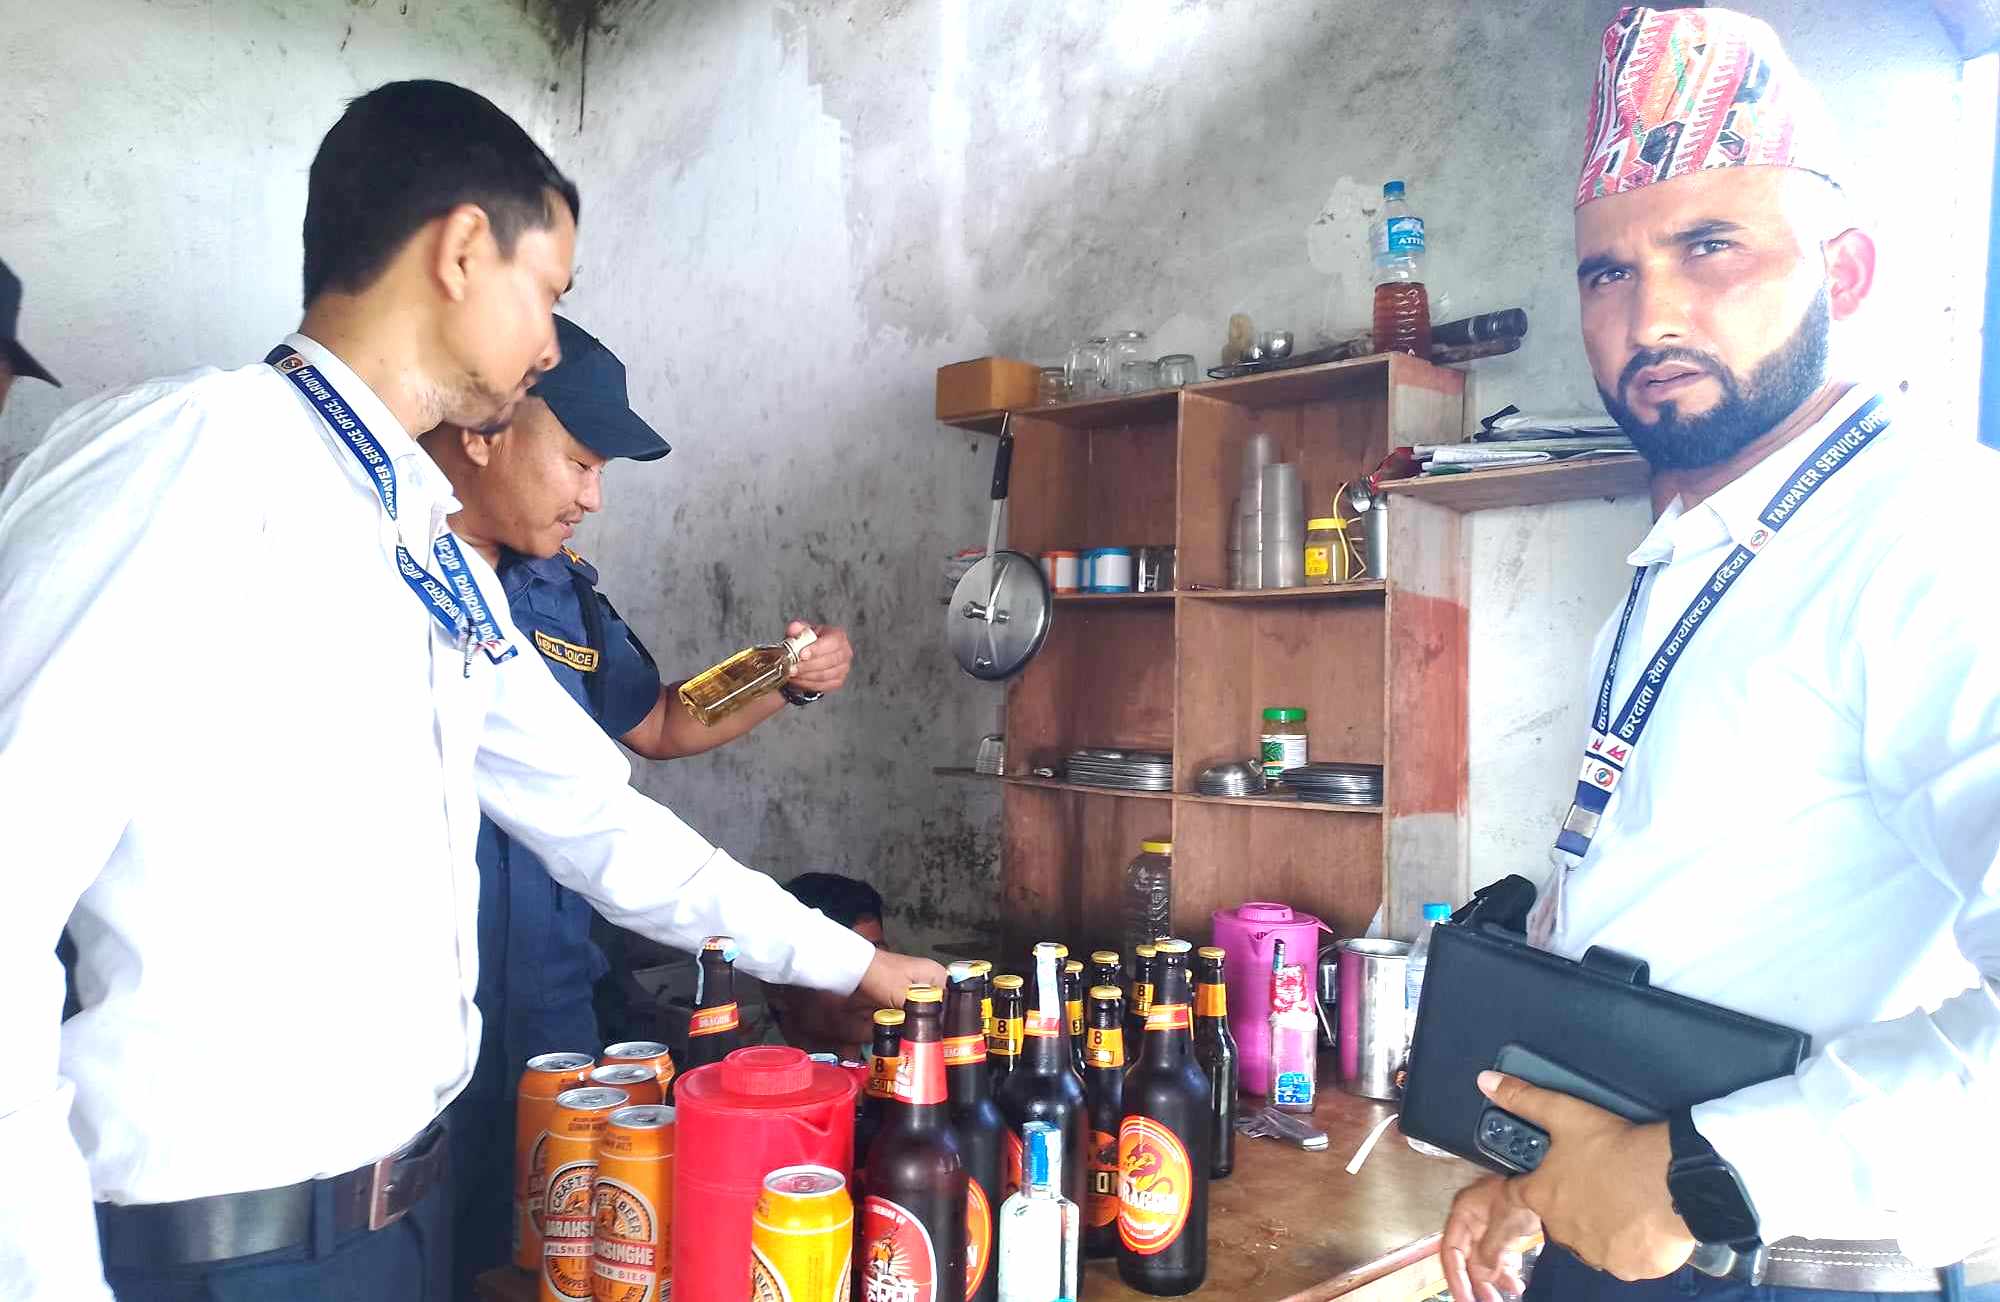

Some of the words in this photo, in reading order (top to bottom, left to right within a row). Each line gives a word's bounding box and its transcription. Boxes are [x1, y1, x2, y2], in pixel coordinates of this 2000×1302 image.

[295, 367, 332, 401] BARDIYA
[347, 429, 383, 465] SERVICE
[1766, 467, 1823, 523] TAXPAYER
[1815, 427, 1866, 473] SERVICE
[1618, 685, 1655, 739] करदाता
[1647, 656, 1669, 687] सेवा
[1666, 595, 1713, 657] कार्यालय
[1137, 984, 1146, 997] 8
[997, 1020, 1007, 1034] 8
[1094, 1031, 1103, 1045] 8
[874, 1057, 885, 1074] 8
[553, 1175, 583, 1209] CRAFT
[617, 1200, 641, 1233] BEER
[617, 1268, 648, 1281] BIER
[756, 1273, 775, 1302] BEE
